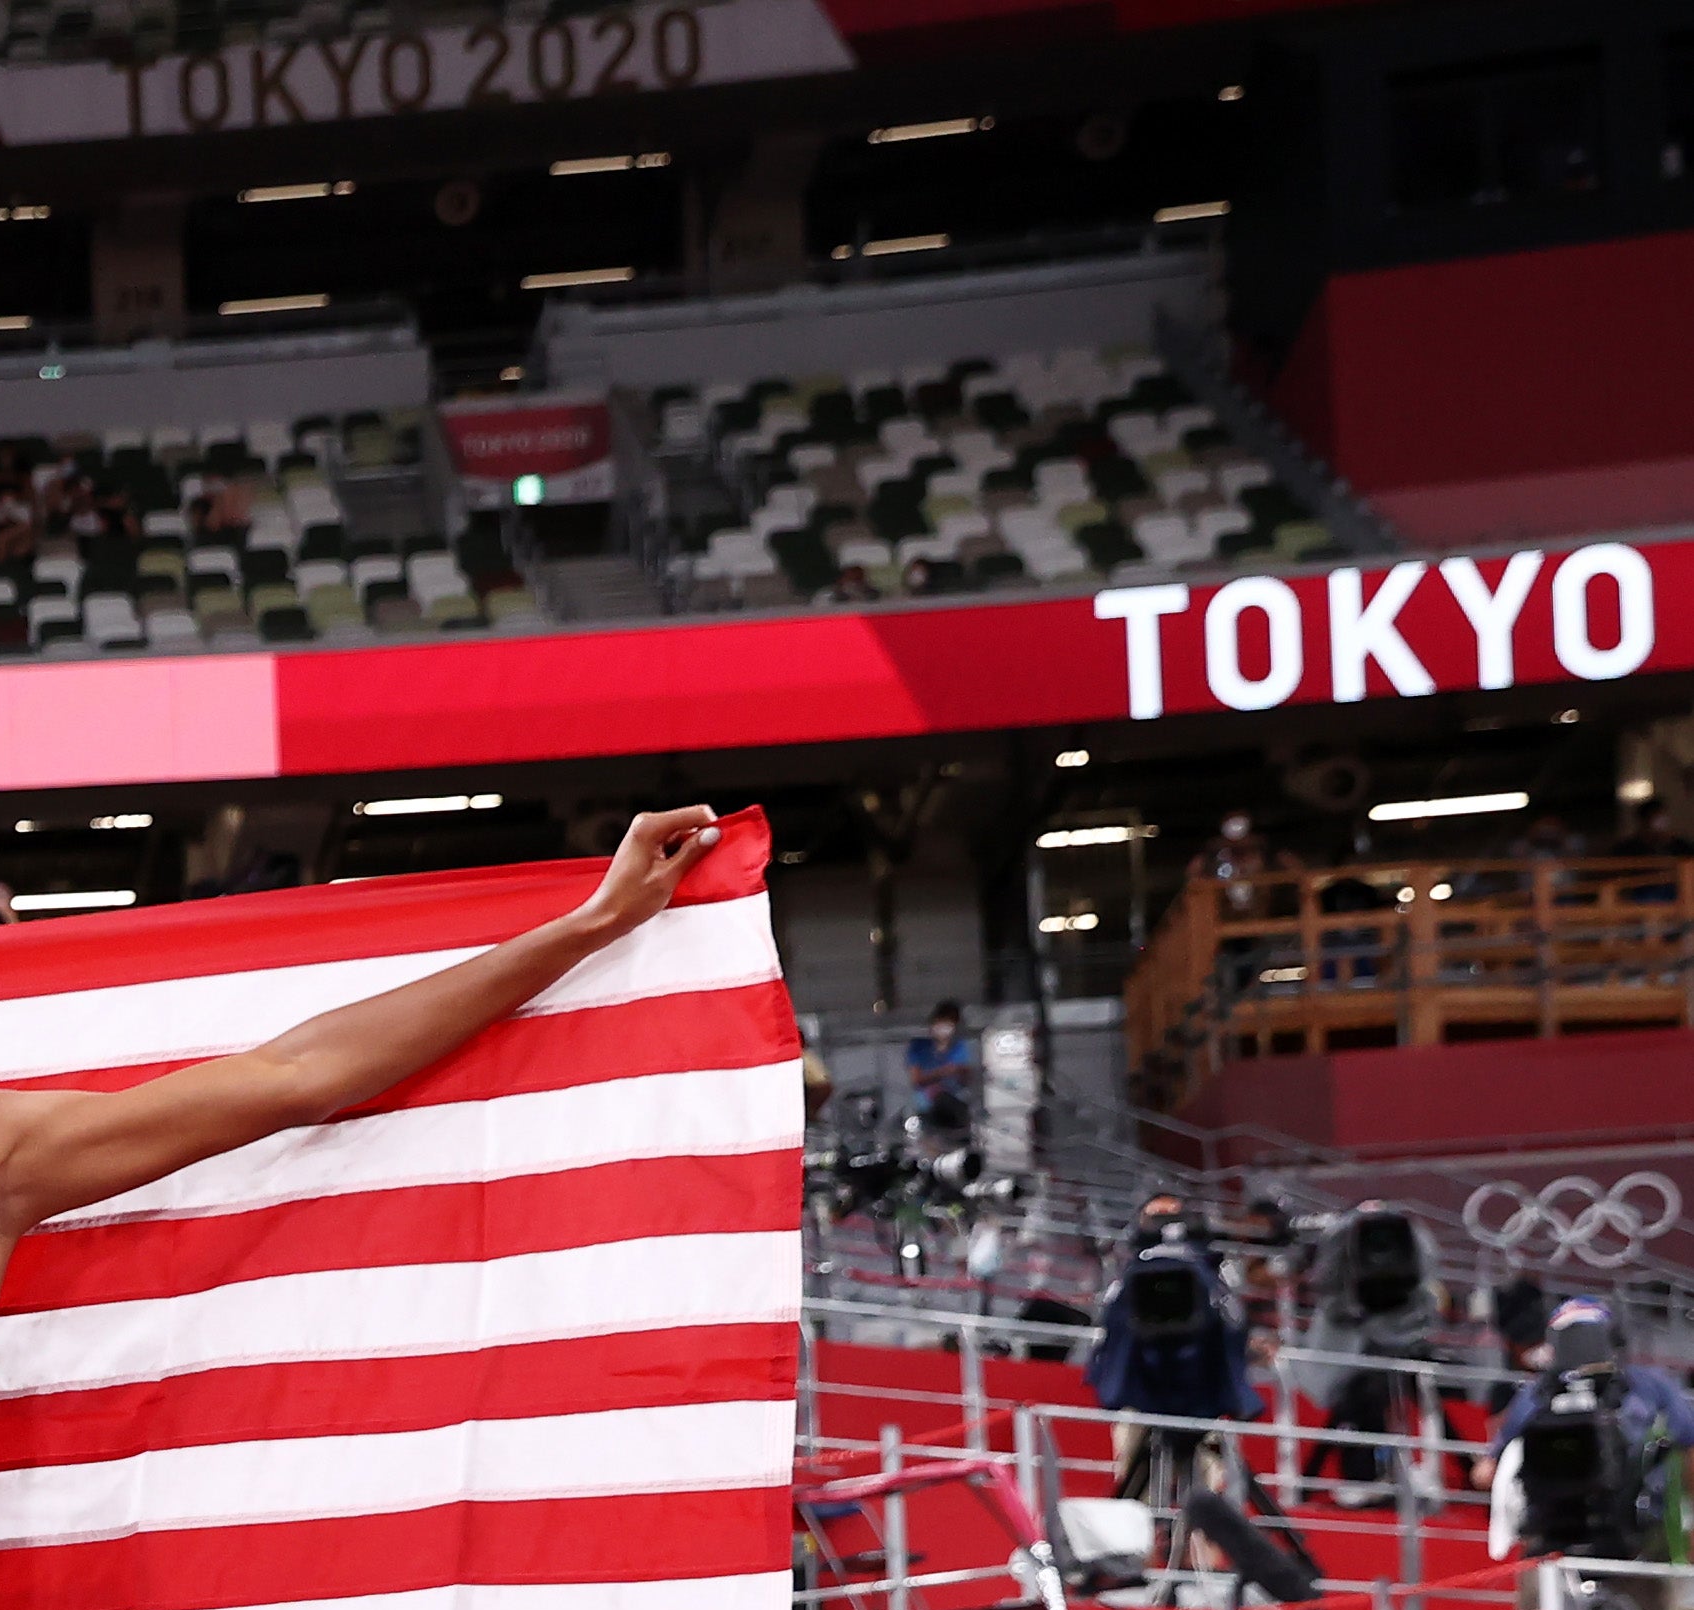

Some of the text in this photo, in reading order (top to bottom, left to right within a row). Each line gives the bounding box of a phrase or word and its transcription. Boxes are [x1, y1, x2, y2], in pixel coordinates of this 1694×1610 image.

[110, 9, 700, 137] TOKYO 2020
[1093, 541, 1655, 720] TOKYO
